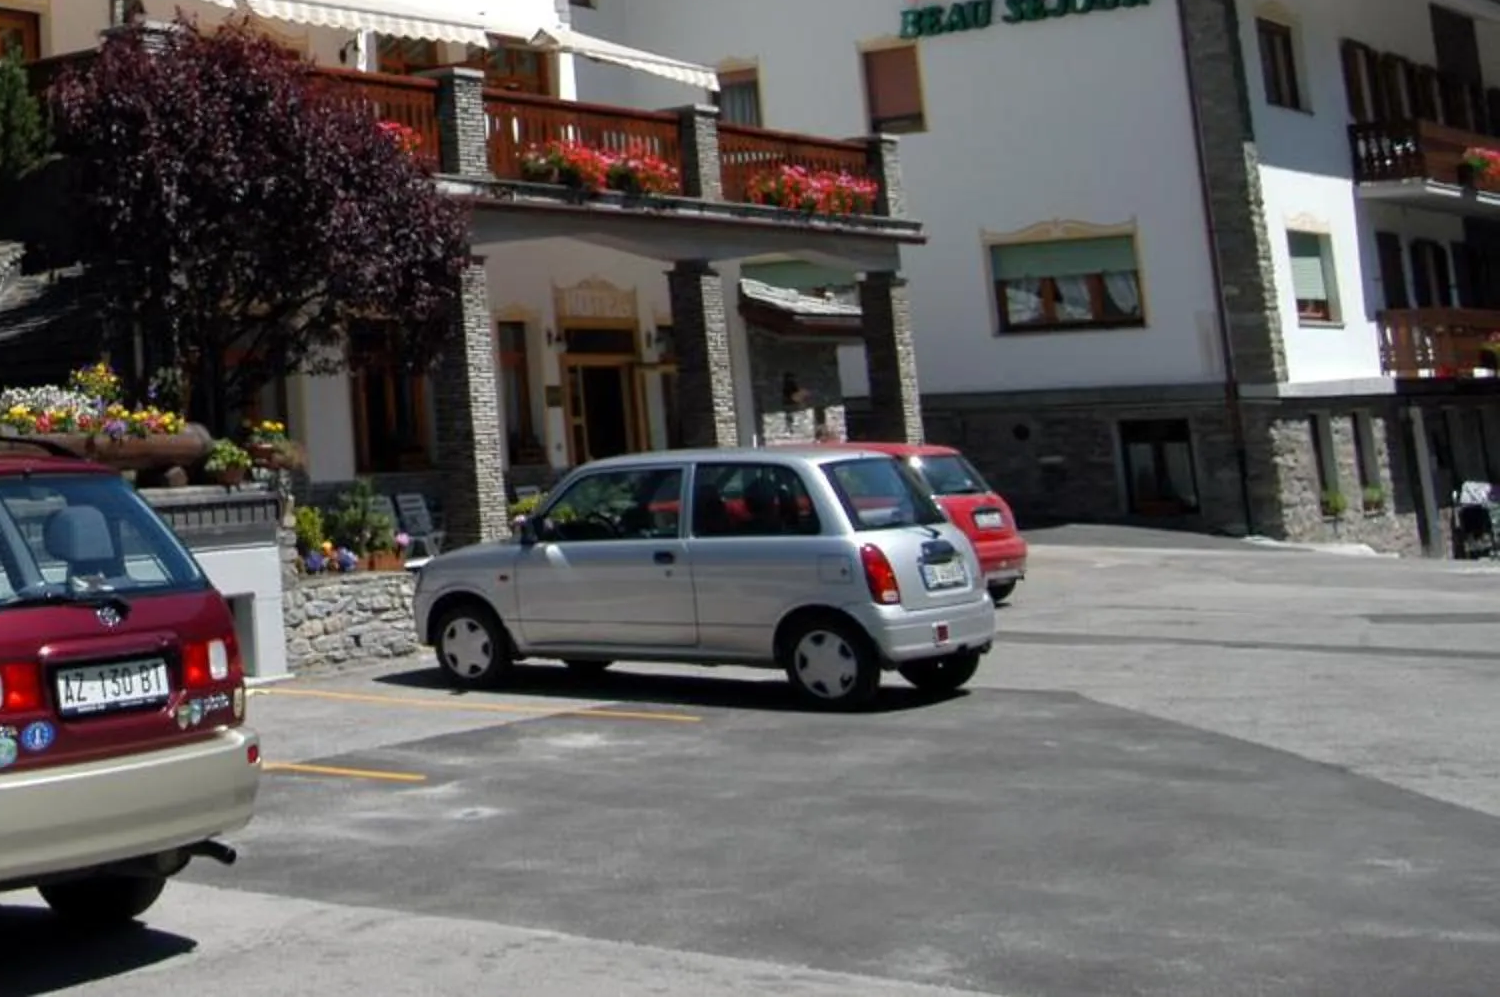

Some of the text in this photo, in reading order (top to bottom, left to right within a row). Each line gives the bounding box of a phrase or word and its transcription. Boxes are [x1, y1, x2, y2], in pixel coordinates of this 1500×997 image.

[900, 0, 993, 39] BEAU
[64, 662, 164, 703] AZ 130 BT
